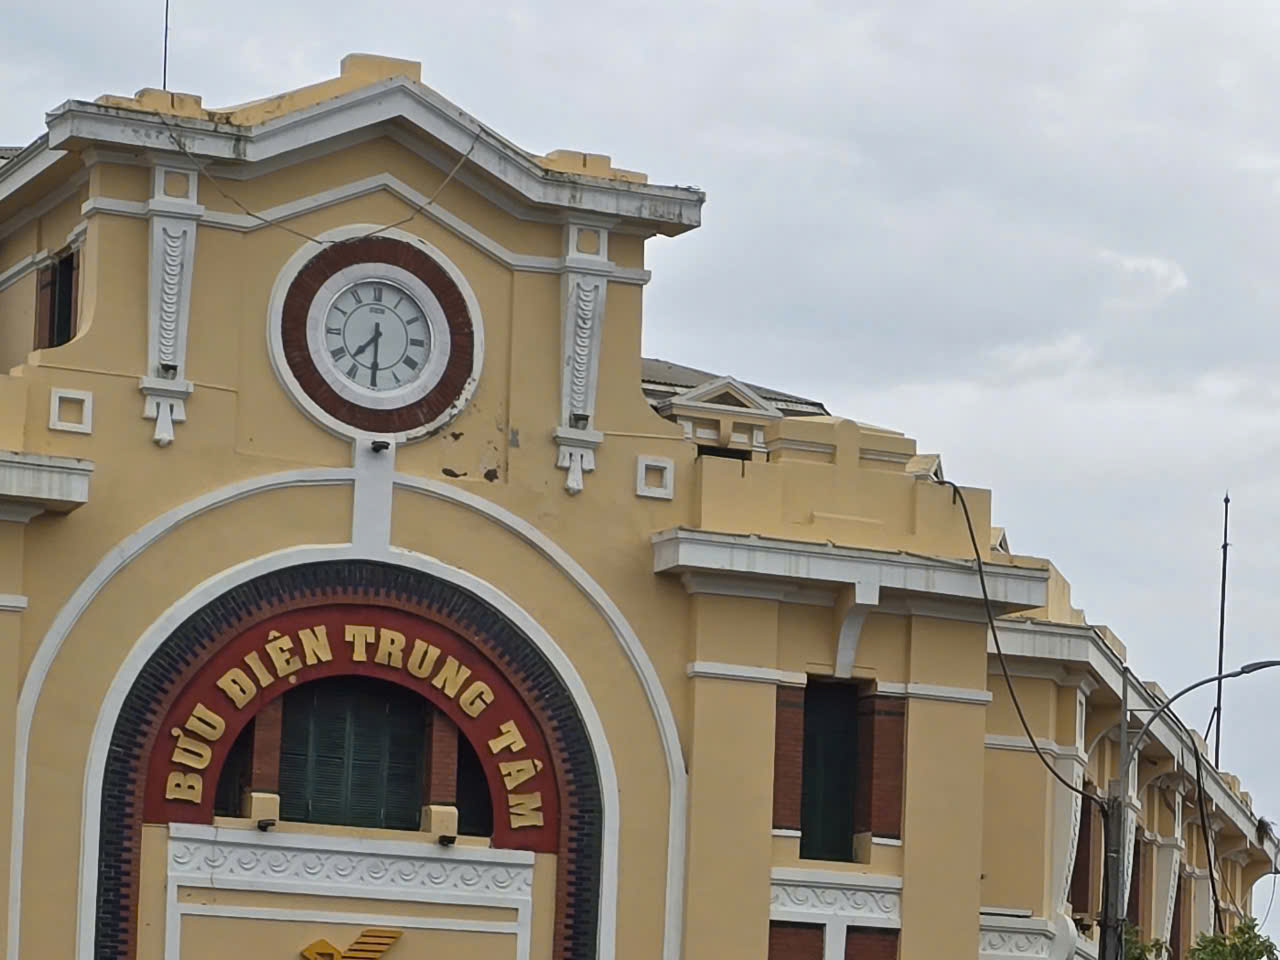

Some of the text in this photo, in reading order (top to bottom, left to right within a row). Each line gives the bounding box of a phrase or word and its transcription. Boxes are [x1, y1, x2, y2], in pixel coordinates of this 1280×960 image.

[166, 624, 544, 829] BƯU ĐIỆN TRUNG TÂM
